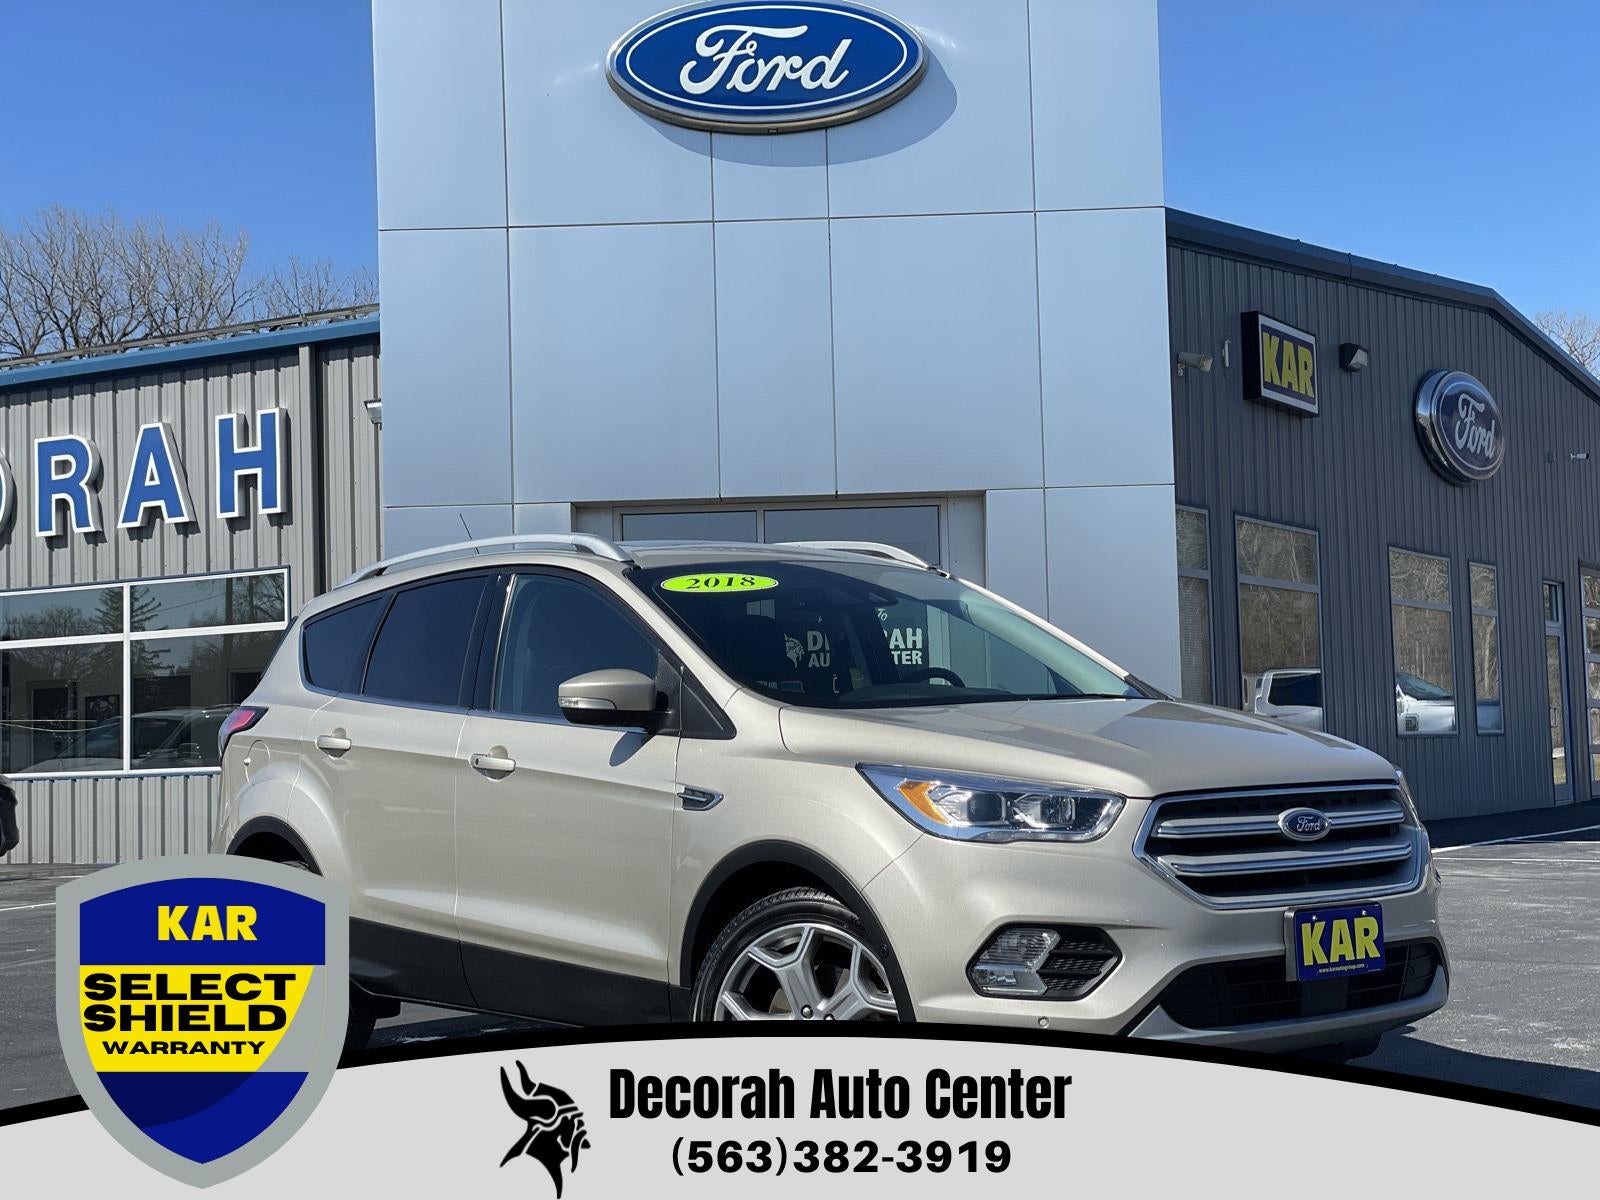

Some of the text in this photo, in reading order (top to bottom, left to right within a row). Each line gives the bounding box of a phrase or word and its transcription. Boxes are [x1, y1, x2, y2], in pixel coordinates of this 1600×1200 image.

[679, 25, 852, 94] Ford
[1263, 331, 1315, 398] KAR
[1454, 393, 1496, 459] Ford
[0, 407, 285, 537] RAH
[685, 576, 755, 590] 2018
[1296, 815, 1322, 832] Ford
[1301, 916, 1381, 966] KAR
